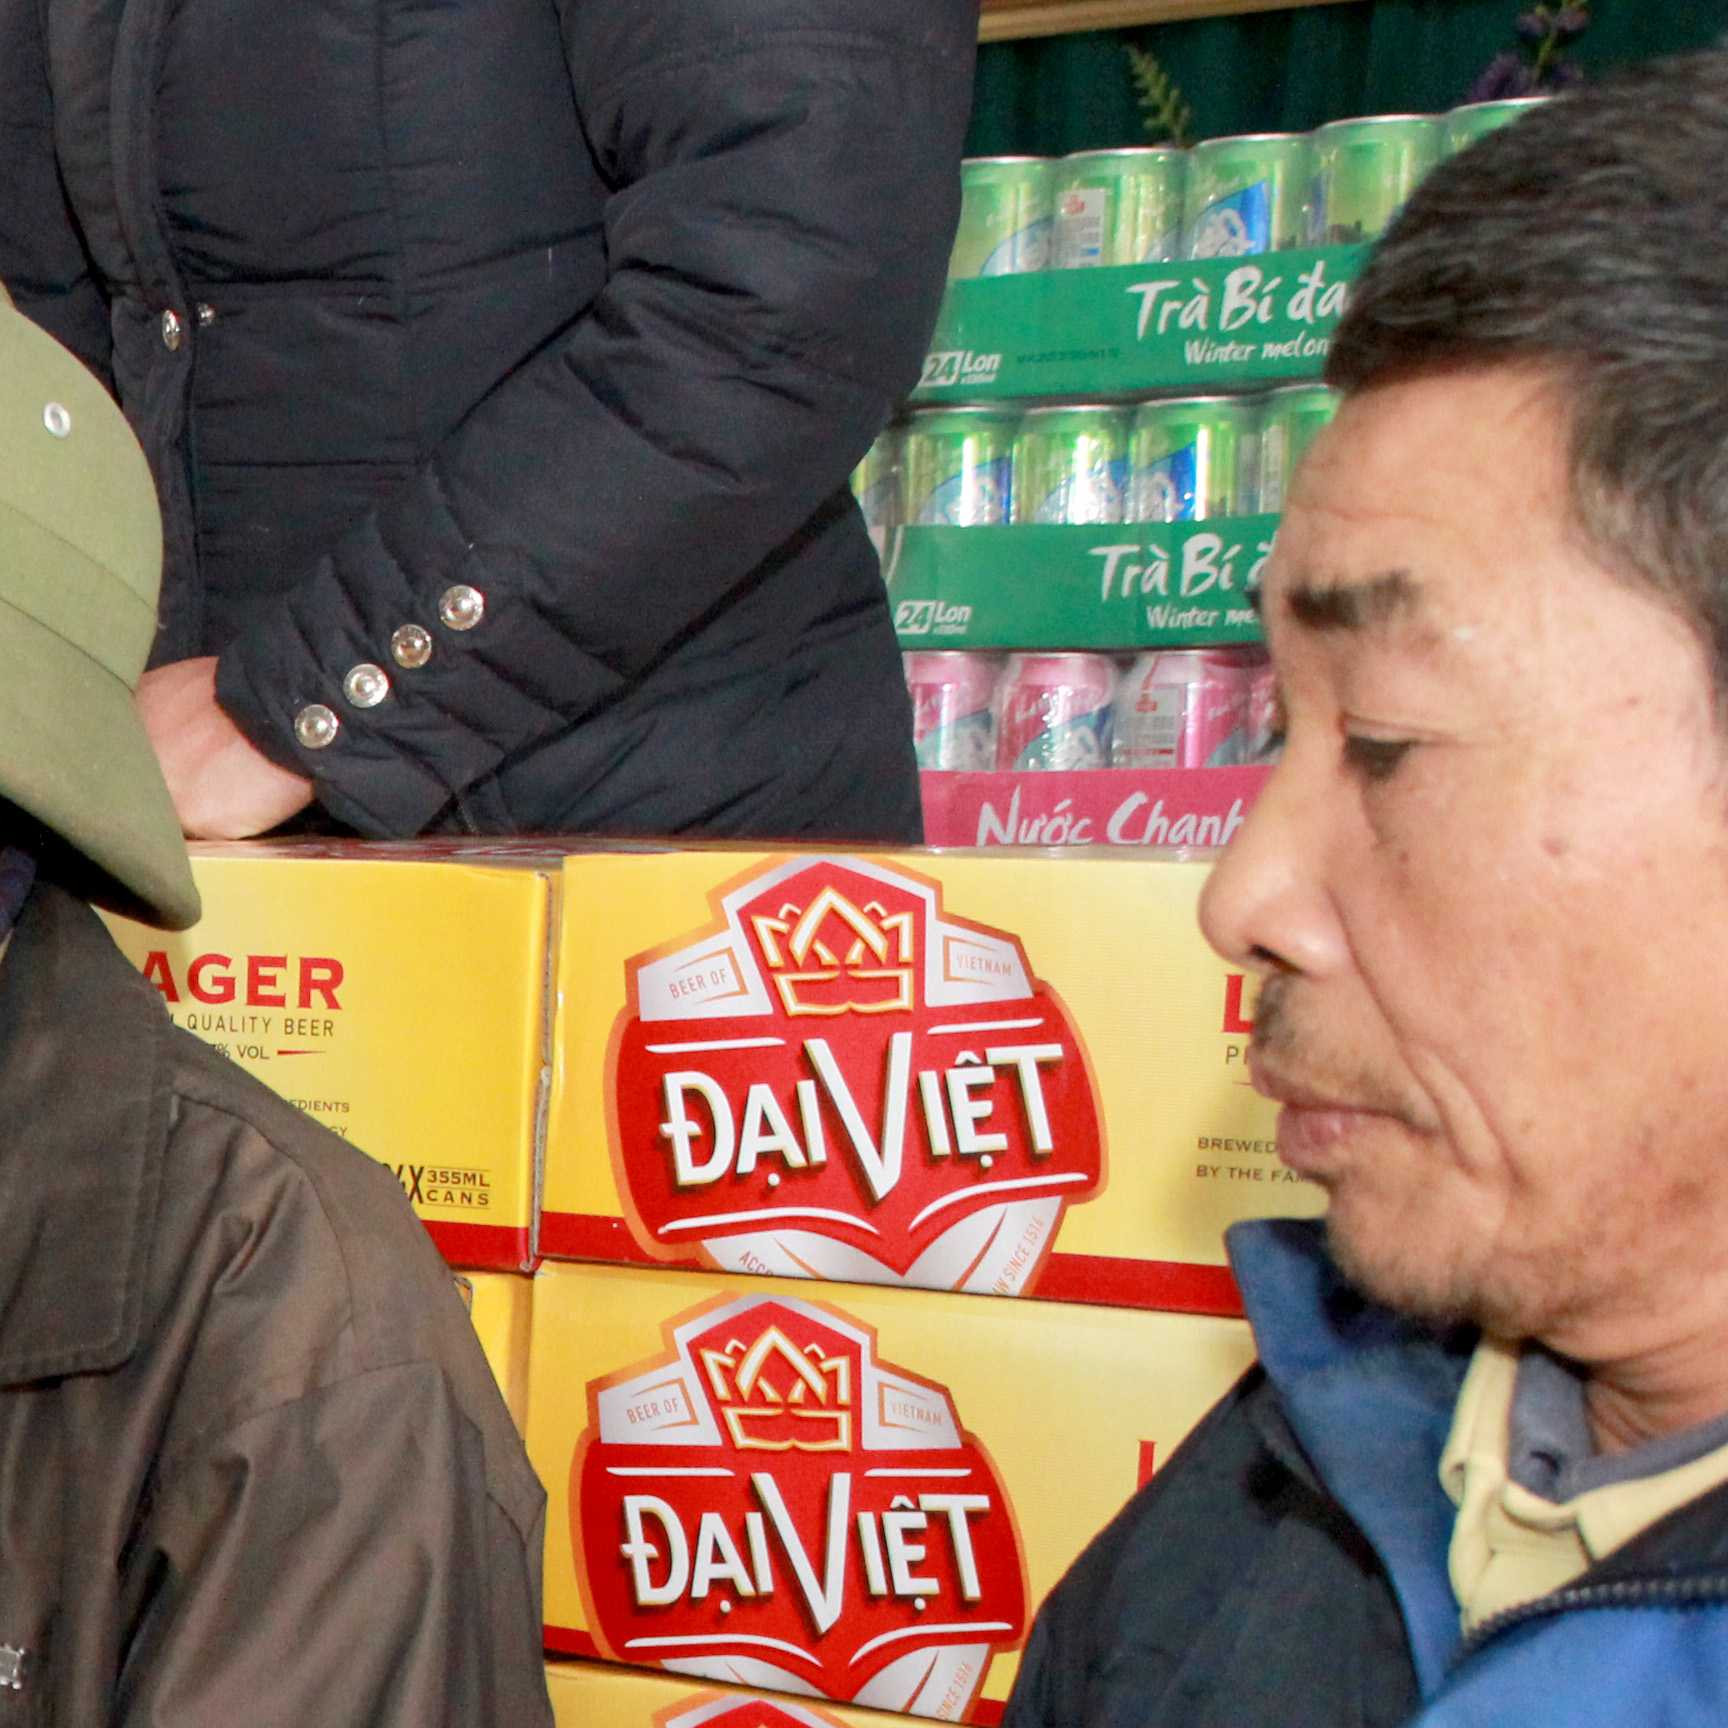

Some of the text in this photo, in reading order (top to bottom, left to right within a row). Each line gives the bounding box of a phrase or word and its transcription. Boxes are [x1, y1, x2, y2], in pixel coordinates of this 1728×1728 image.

[1125, 260, 1351, 341] Trà Bí đa
[962, 352, 1003, 372] Lon
[1184, 338, 1255, 365] Winter
[1088, 542, 1169, 602] Trà
[1181, 533, 1242, 597] Bí
[934, 604, 972, 623] Lon
[1146, 605, 1219, 630] Winter
[977, 784, 1094, 848] Nước
[956, 952, 1014, 979] VIETNAM
[143, 951, 345, 1010] AGER
[668, 969, 729, 1000] BEER OF
[186, 1014, 335, 1037] QUALITY BEER
[237, 1045, 270, 1060] VOL
[426, 1169, 491, 1188] 355ML
[1196, 1165, 1221, 1179] BY
[1227, 1166, 1264, 1181] THE
[426, 1189, 490, 1206] CANS
[626, 1397, 680, 1425] BEER OF
[891, 1401, 942, 1427] VIETNAM
